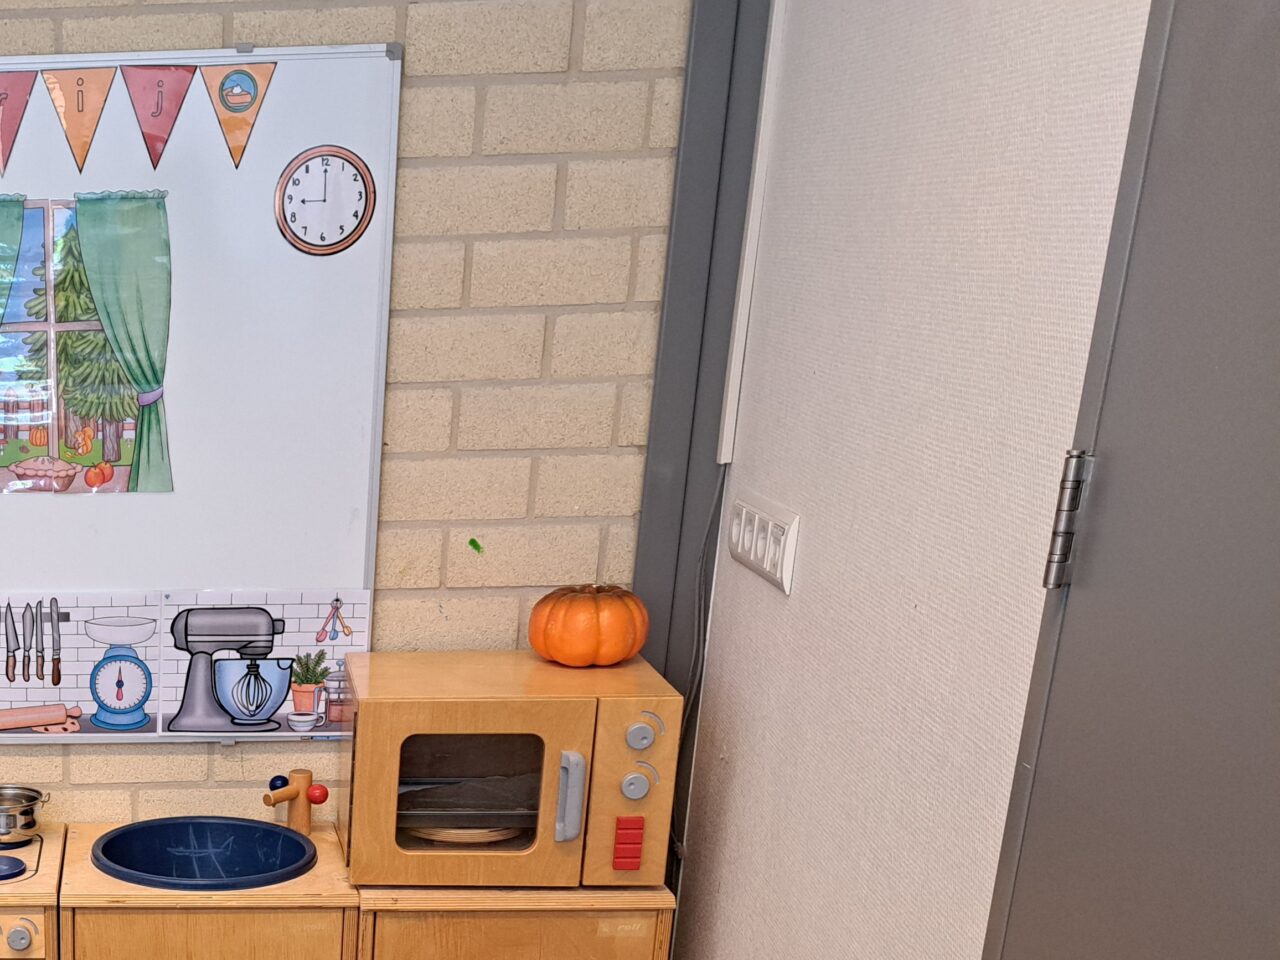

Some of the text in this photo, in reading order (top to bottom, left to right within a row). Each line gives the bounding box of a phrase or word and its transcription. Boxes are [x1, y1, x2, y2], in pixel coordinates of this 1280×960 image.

[321, 157, 331, 167] 12
[291, 177, 301, 187] 10
[352, 173, 359, 182] 2
[287, 194, 294, 204] 9
[357, 191, 363, 202] 3
[290, 212, 297, 223] 8
[352, 210, 359, 221] 4
[301, 226, 308, 237] 7
[339, 225, 345, 236] 5
[320, 232, 326, 242] 6
